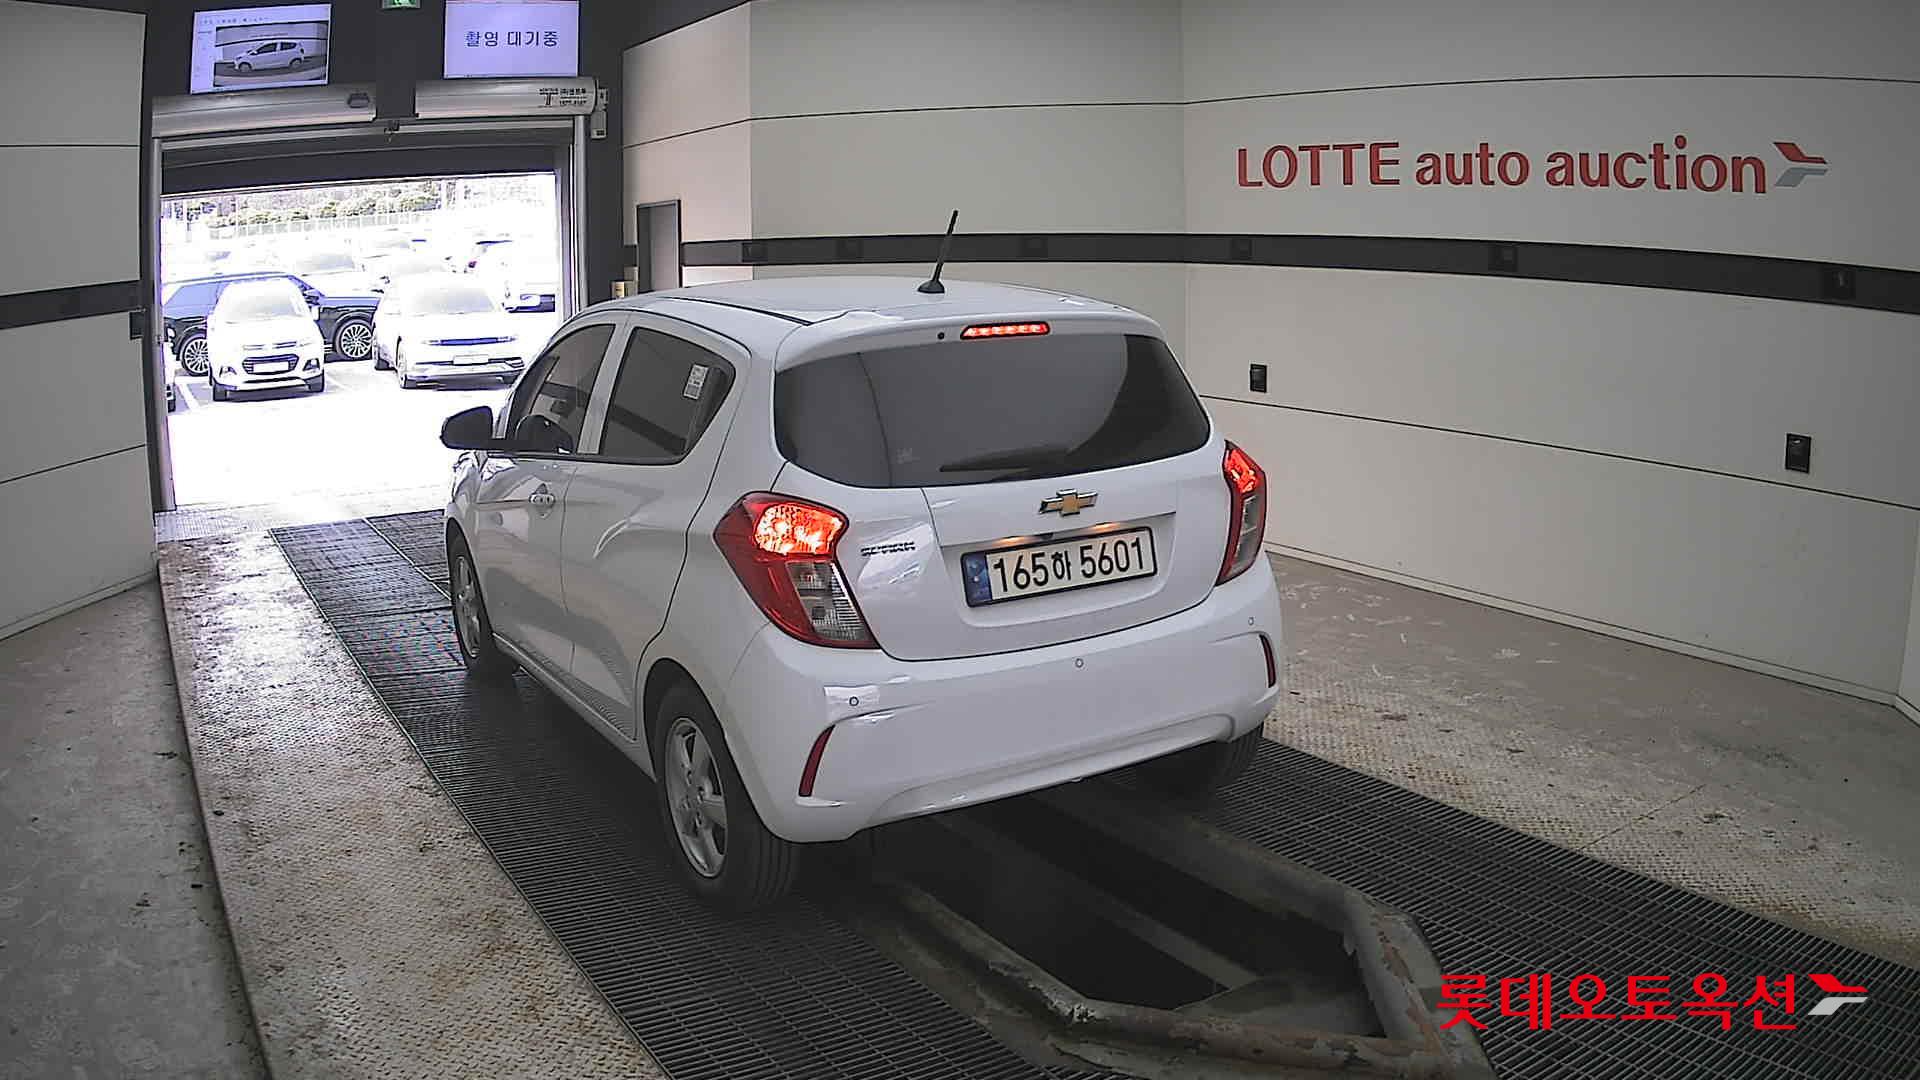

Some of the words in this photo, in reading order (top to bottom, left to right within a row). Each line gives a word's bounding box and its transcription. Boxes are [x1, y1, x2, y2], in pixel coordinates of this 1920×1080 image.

[507, 31, 559, 48] 대기중
[1237, 141, 1400, 188] LOTTE
[1414, 142, 1530, 187] auto
[1545, 135, 1767, 194] auction
[993, 548, 1073, 593] 165하
[1080, 536, 1145, 579] 5601
